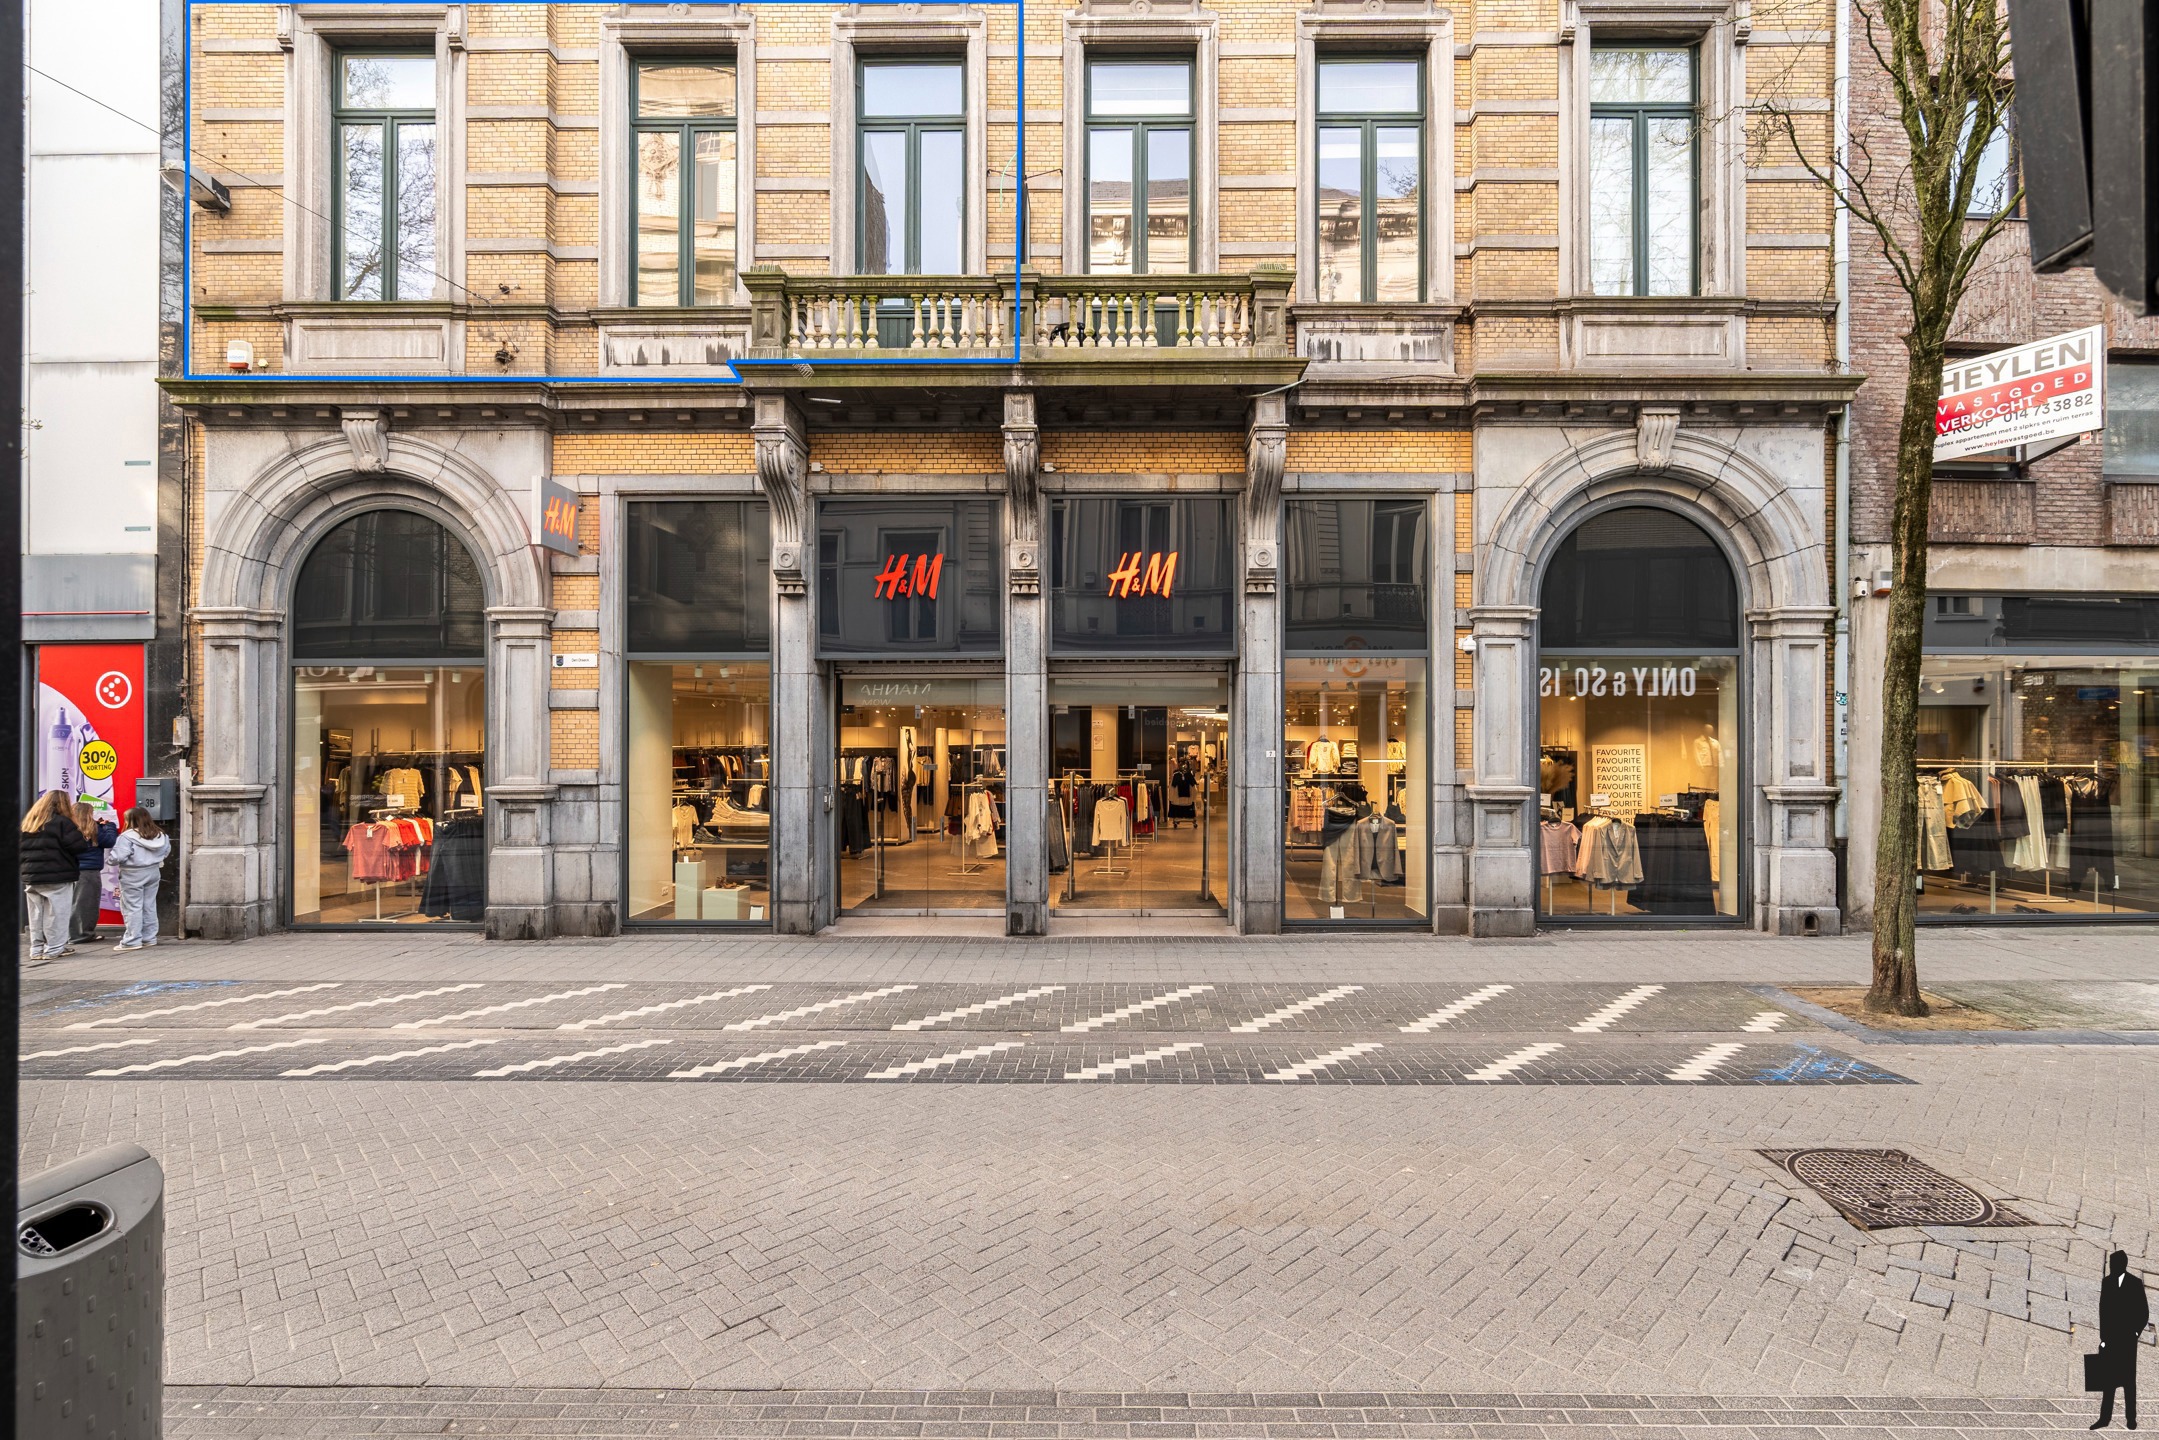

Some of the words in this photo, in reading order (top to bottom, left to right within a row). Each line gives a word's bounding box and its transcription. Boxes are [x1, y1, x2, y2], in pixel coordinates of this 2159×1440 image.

[1940, 338, 2086, 396] HEYLEN
[1937, 372, 2087, 416] VASTGOED
[1939, 395, 2036, 432] VERKOCHT
[1955, 431, 1997, 444] appartement
[2019, 421, 2041, 430] slpkrs
[2071, 410, 2094, 419] terras
[1964, 429, 2055, 452] www.heylenvastgoed.be
[543, 495, 577, 542] H&M
[874, 553, 944, 600] H&M
[1107, 551, 1178, 599] H&M
[82, 750, 115, 764] 30%
[1596, 748, 1641, 756] FAVOURITE
[62, 768, 70, 789] SKIN
[145, 799, 155, 808] 3B
